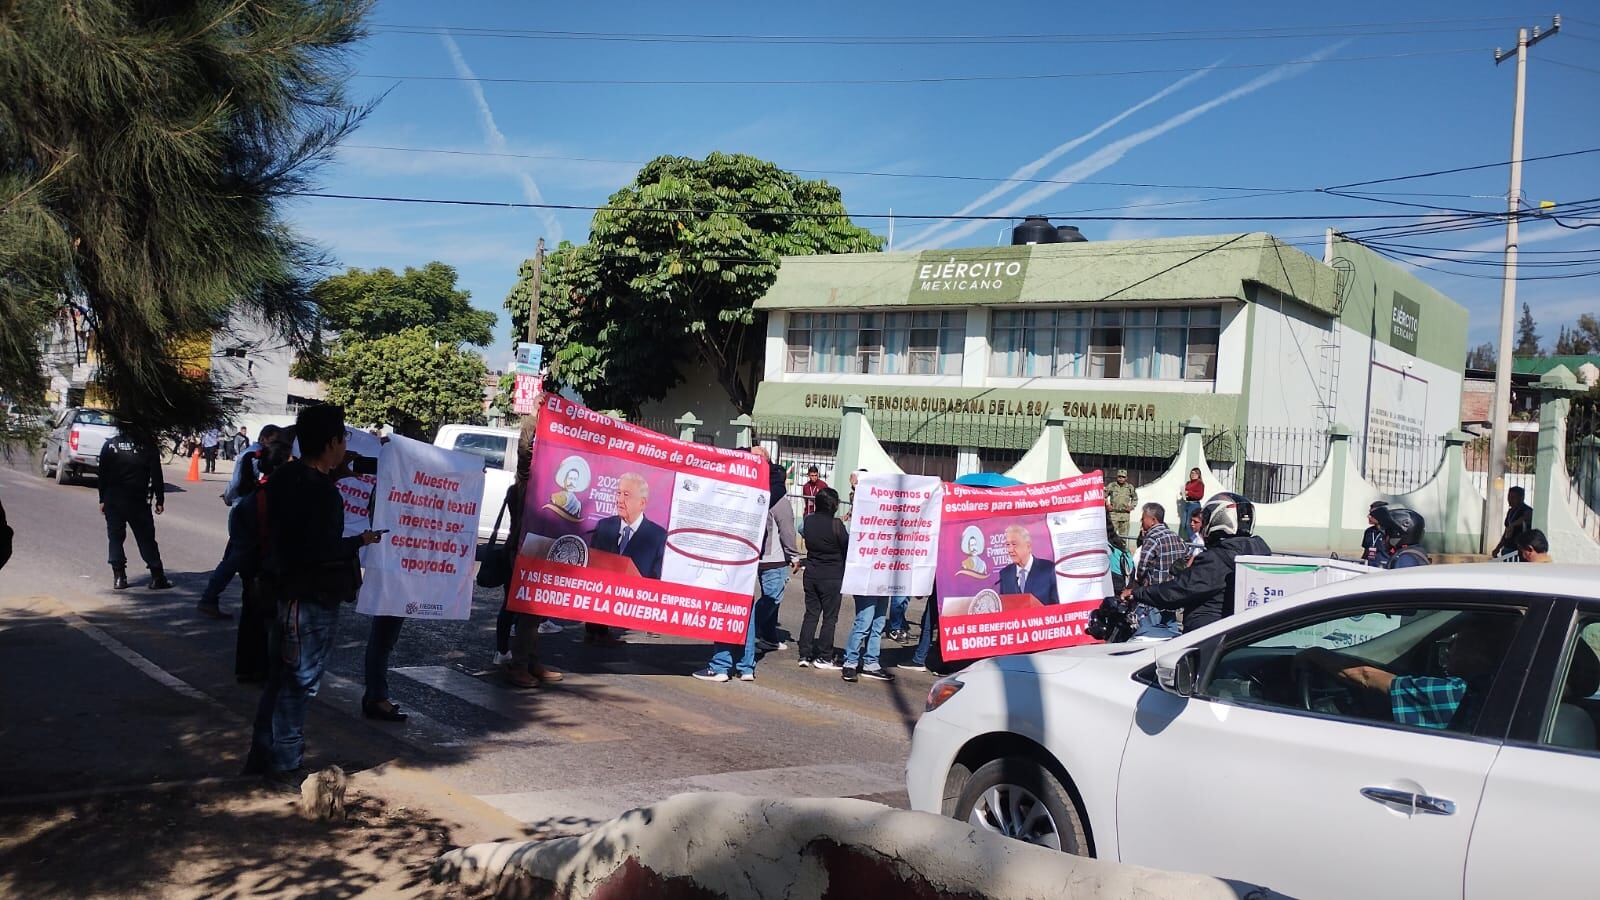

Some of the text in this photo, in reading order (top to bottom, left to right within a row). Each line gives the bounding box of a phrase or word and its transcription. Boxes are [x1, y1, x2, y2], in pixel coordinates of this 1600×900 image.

[919, 257, 1021, 279] EJÉRCITO
[920, 279, 1003, 292] MEXICANO
[547, 397, 562, 413] EL
[988, 400, 1005, 415] DE
[1007, 401, 1023, 416] LA
[1062, 402, 1097, 418] ZONA
[1101, 402, 1156, 421] MILITAR
[549, 421, 606, 445] escolares
[608, 437, 635, 455] para
[637, 442, 667, 460] niños
[669, 451, 683, 463] de
[728, 462, 758, 480] AMLO
[413, 470, 460, 492] Nuestra
[388, 487, 477, 516] industria textil
[870, 487, 931, 499] Apoyemos a
[879, 503, 921, 513] nuestros
[945, 500, 989, 513] escolares
[991, 501, 1013, 512] para
[1014, 498, 1038, 509] niños
[1040, 498, 1050, 507] de
[398, 514, 465, 534] merece ser
[859, 516, 932, 528] talleres textiles
[391, 534, 469, 558] escuchada y
[857, 531, 931, 542] y a las familias
[858, 546, 928, 558] que dependen
[401, 556, 457, 574] apoyada.
[874, 560, 886, 570] de
[520, 568, 748, 617] Y ASÍ SE BENEFICIÓ A UNA SOLA EMPRESA Y DEJANDO
[1263, 586, 1284, 597] San
[516, 585, 745, 634] AL BORDE DE LA QUIEBRA A MÁS DE 100
[944, 627, 951, 636] Y
[952, 623, 965, 635] ASÍ
[967, 624, 977, 634] SE
[979, 618, 1020, 633] BENEFICIÓ
[1021, 620, 1028, 629] A
[1029, 616, 1044, 627] UNA
[1045, 614, 1063, 625] SOLA
[946, 638, 960, 652] AL
[962, 634, 997, 650] BORDE
[1000, 633, 1014, 645] DE
[1016, 632, 1030, 644] LA
[1031, 626, 1073, 642] QUIEBRA
[1074, 624, 1083, 636] A
